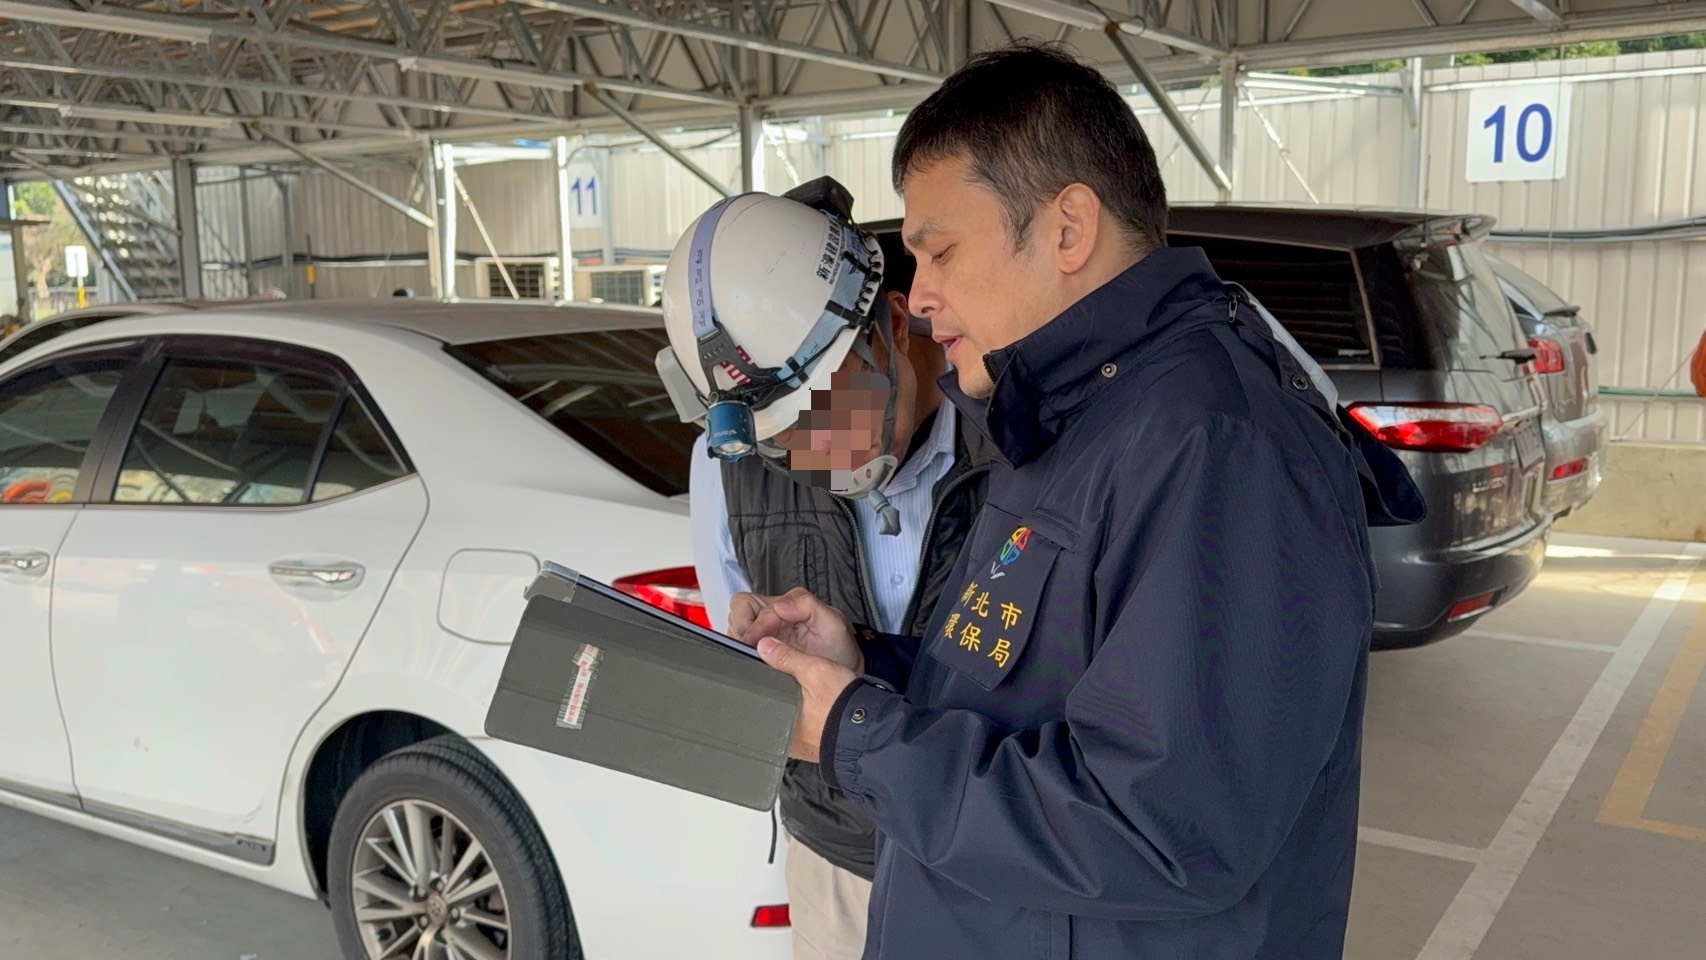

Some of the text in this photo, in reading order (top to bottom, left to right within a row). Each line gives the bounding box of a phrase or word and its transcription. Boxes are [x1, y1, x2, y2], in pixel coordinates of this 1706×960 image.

[1483, 103, 1553, 164] 10
[571, 176, 597, 217] 11
[960, 581, 1023, 631] 新北市
[944, 612, 1012, 669] 環保局
